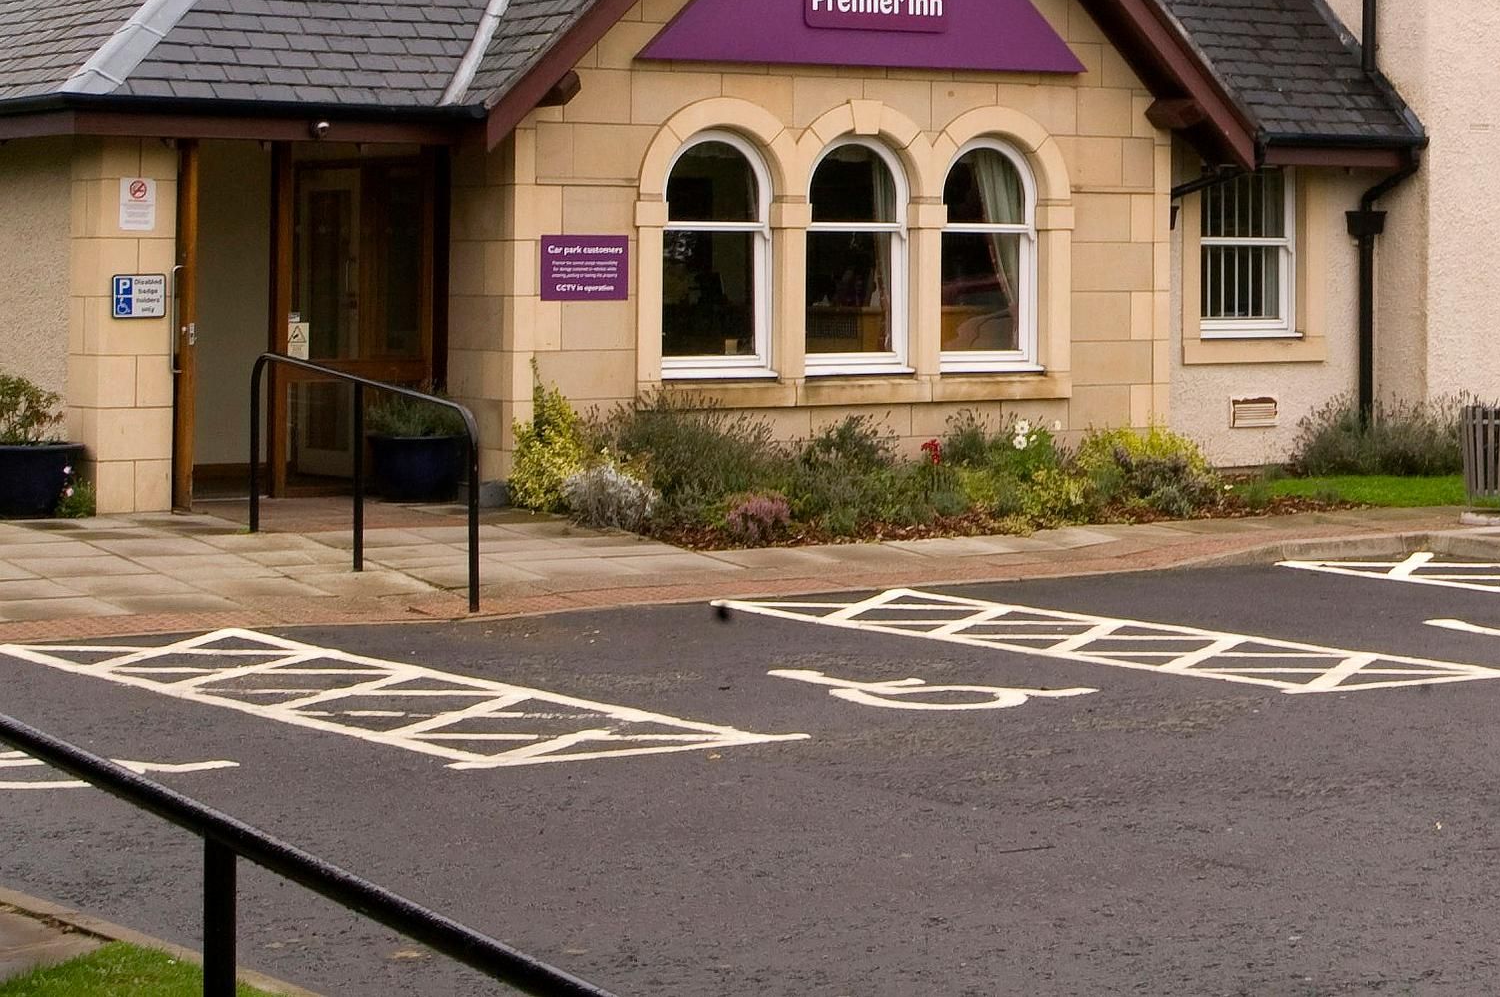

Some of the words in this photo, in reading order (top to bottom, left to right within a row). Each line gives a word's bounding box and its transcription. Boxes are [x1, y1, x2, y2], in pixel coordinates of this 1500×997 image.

[548, 245, 563, 254] Car
[563, 246, 582, 256] park
[582, 246, 623, 254] customers
[119, 279, 131, 294] P
